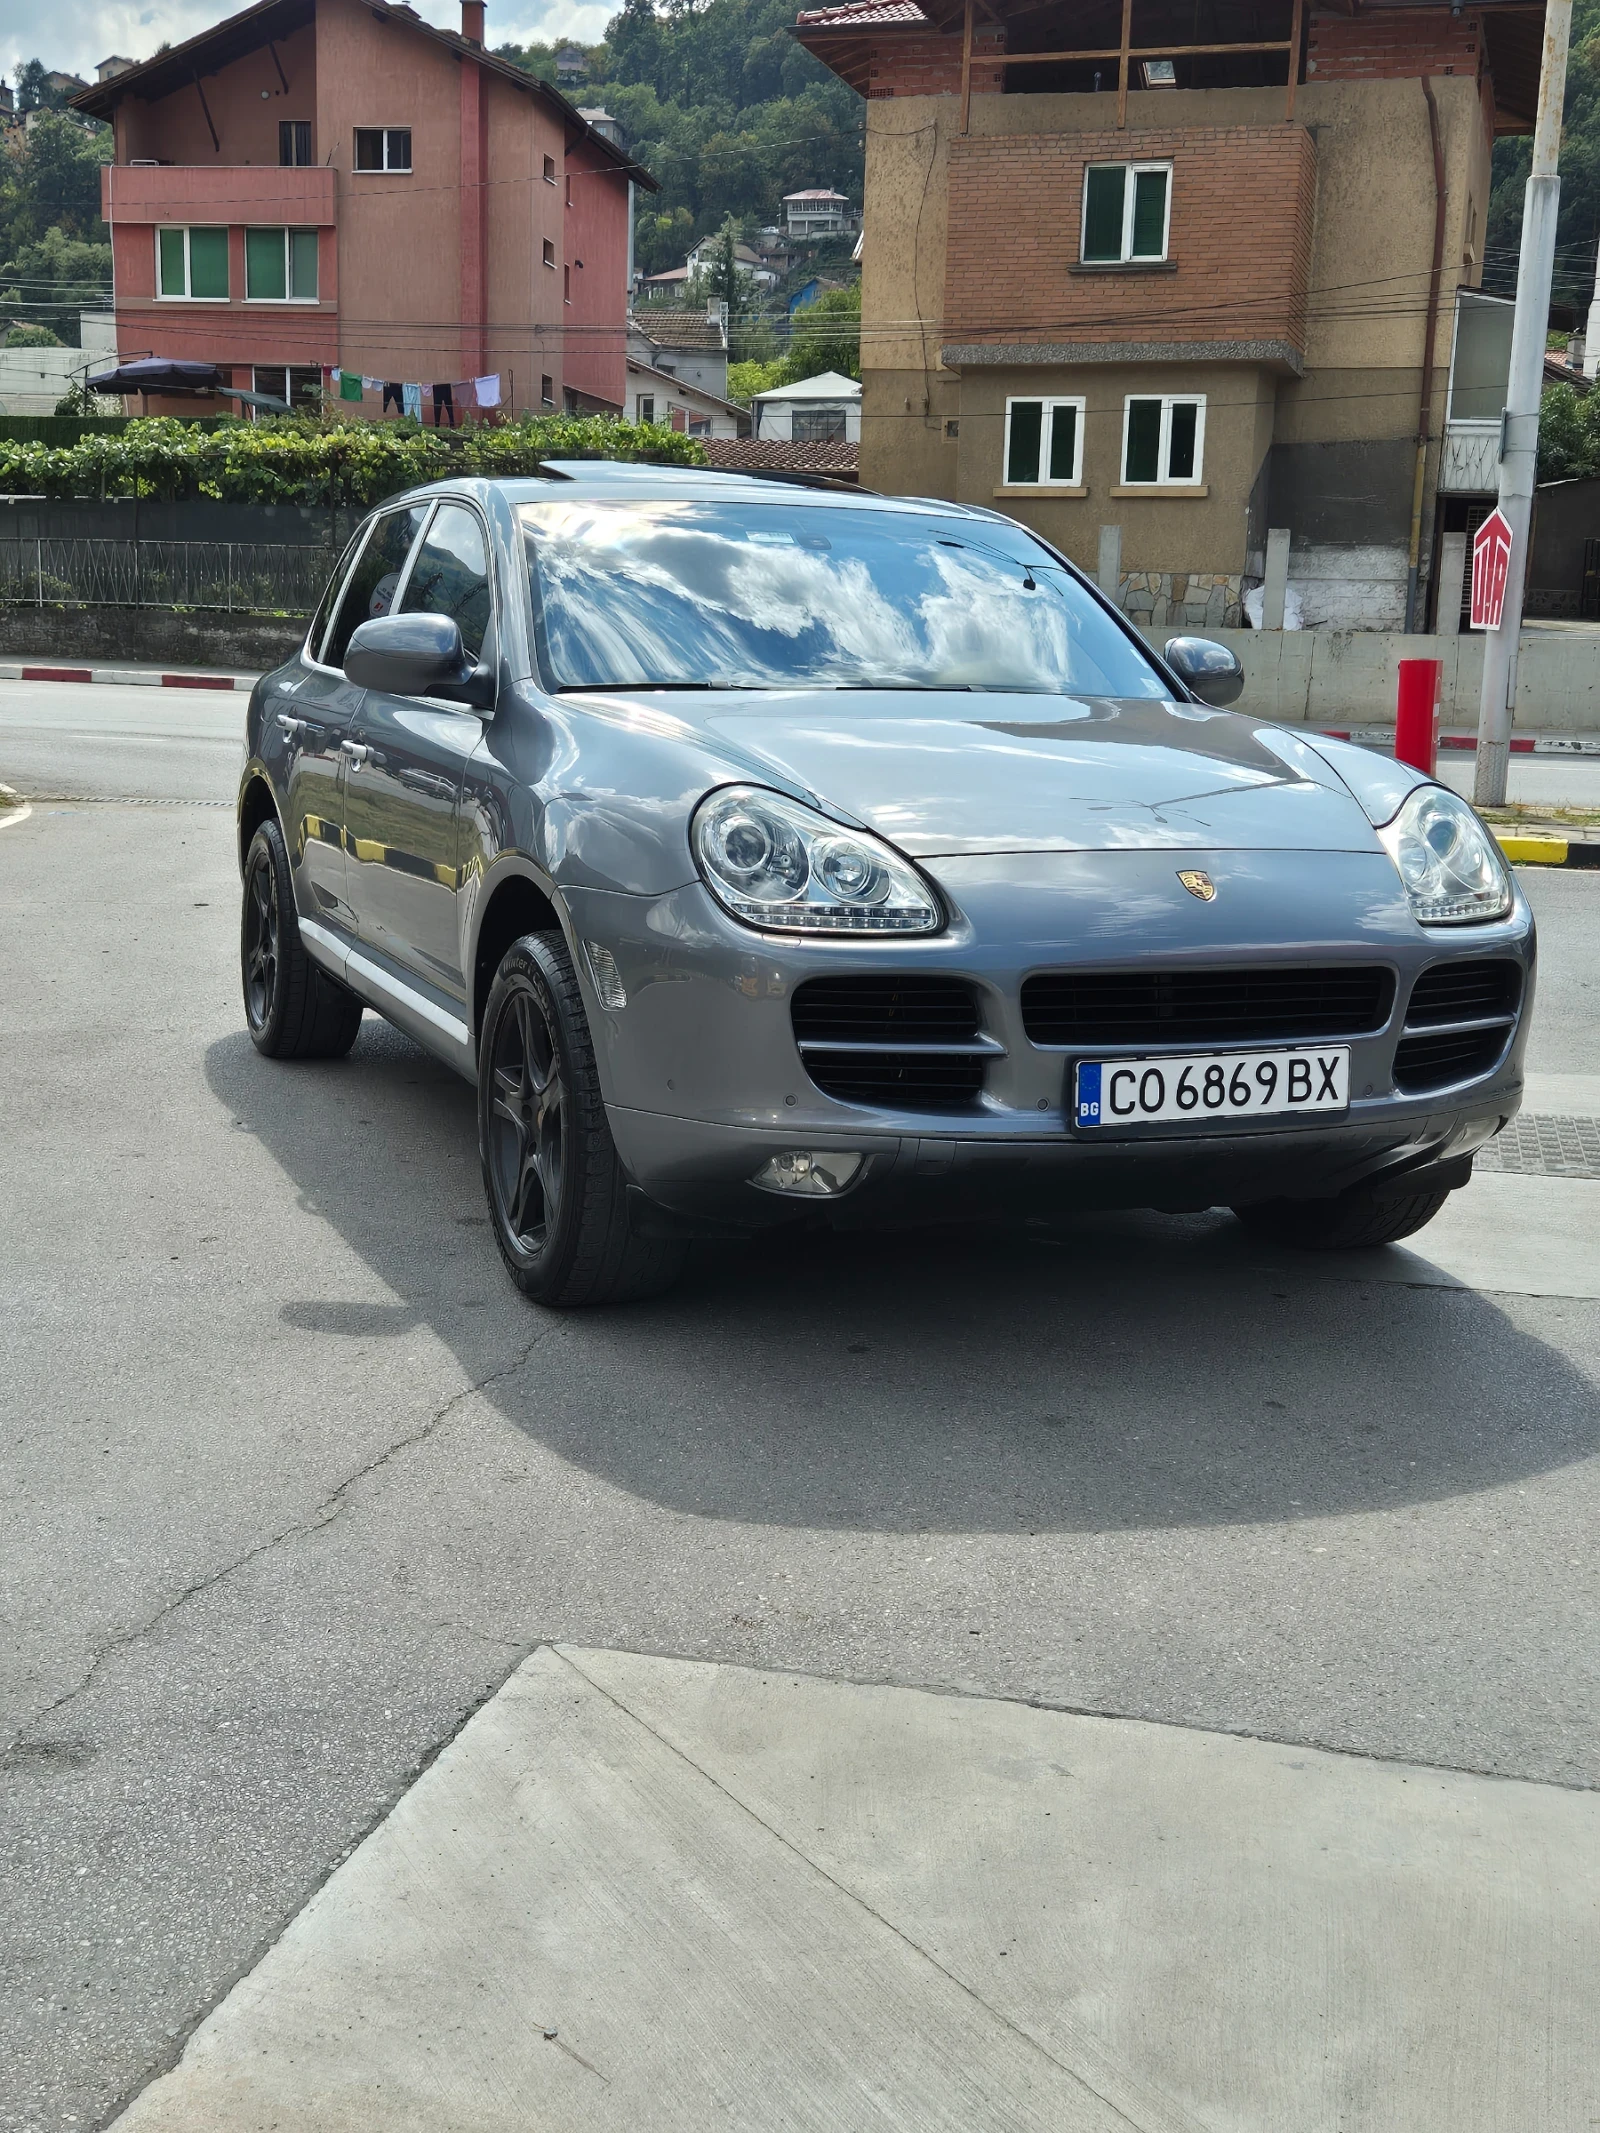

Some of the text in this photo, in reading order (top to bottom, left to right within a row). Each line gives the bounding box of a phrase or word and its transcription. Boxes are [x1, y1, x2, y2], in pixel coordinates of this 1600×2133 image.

[1109, 1056, 1341, 1115] CO 6869 BX
[1080, 1101, 1099, 1116] BG
